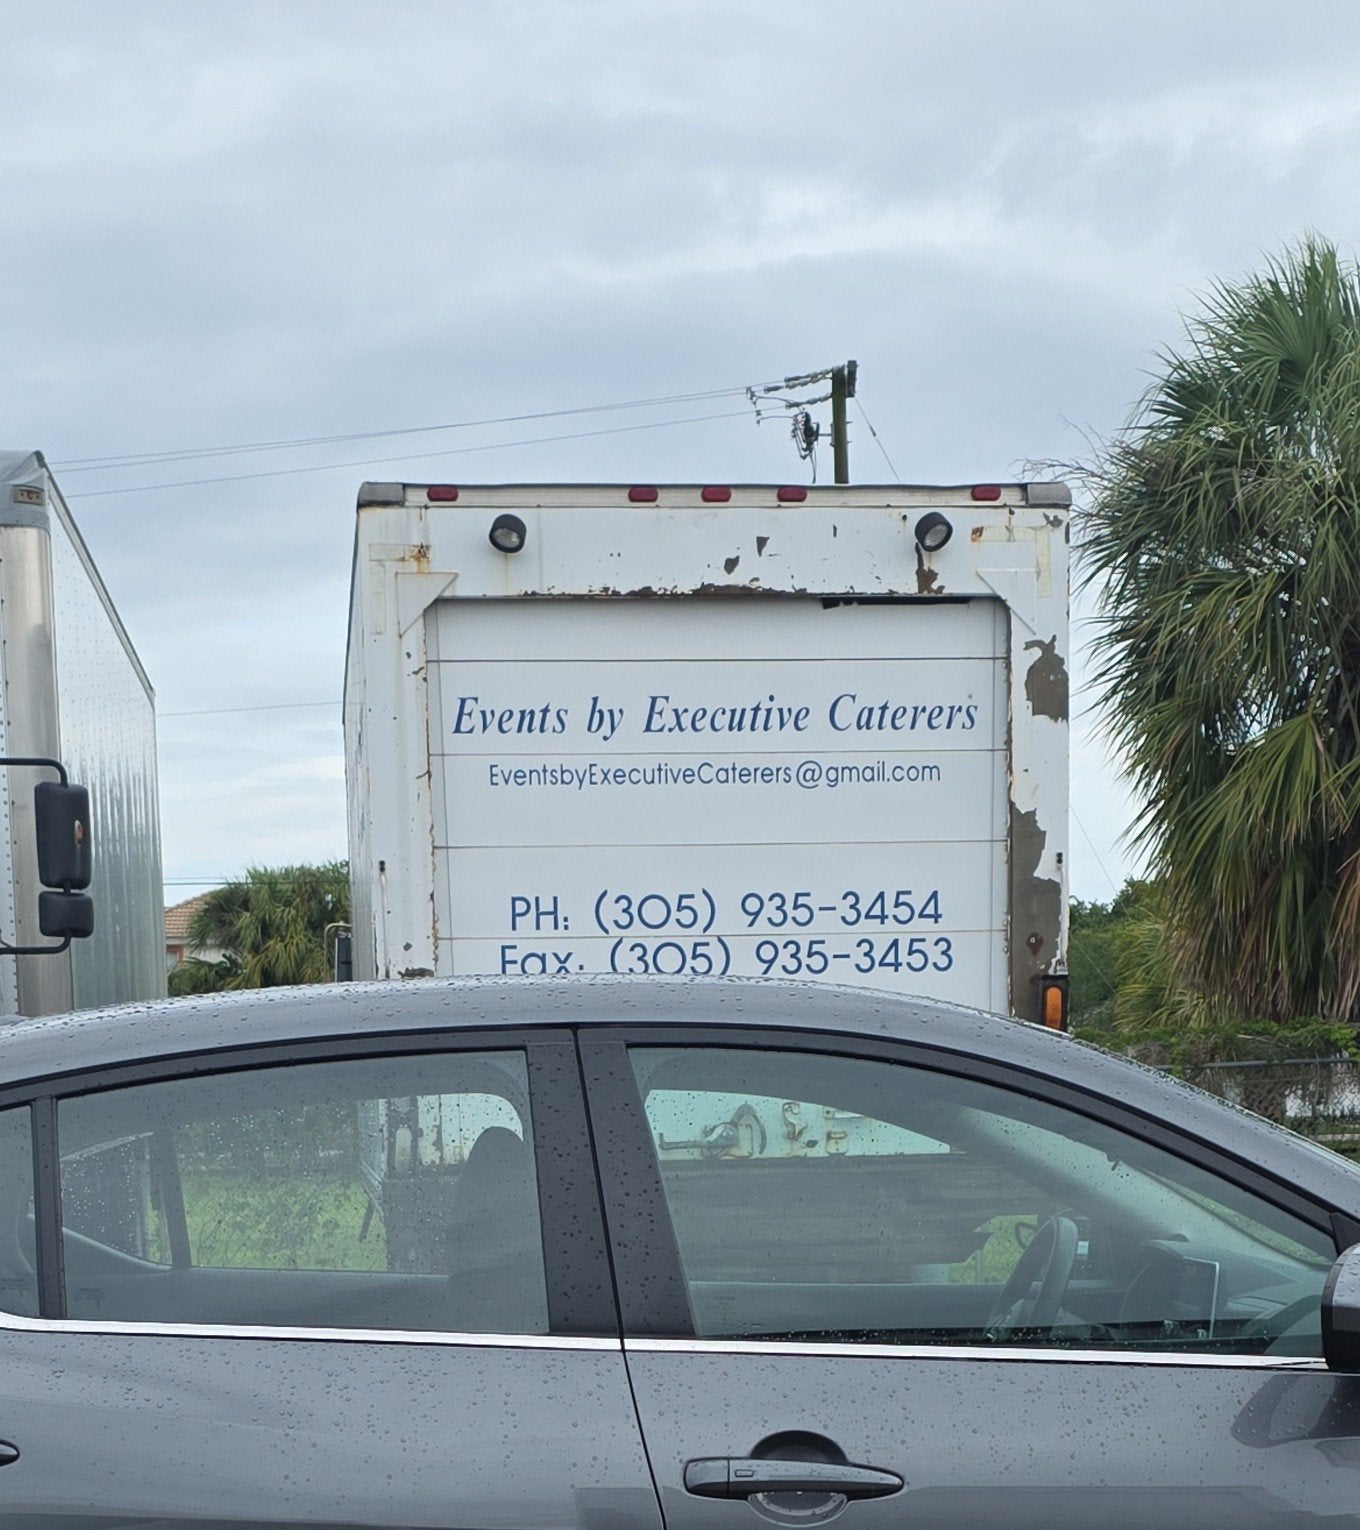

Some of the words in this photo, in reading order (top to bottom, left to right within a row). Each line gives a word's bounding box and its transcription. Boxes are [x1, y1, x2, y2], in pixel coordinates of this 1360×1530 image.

[452, 696, 569, 735] Events
[586, 695, 624, 742] by
[642, 693, 811, 733] Executive
[828, 693, 979, 732] Caterers
[489, 760, 941, 790] EventsbyExecutiveCaterers@gmail.com
[510, 895, 570, 931] PH:
[594, 887, 716, 935] (305)
[740, 889, 943, 928] 935-3454
[609, 936, 731, 976] (305)
[755, 936, 954, 976] 935-3453
